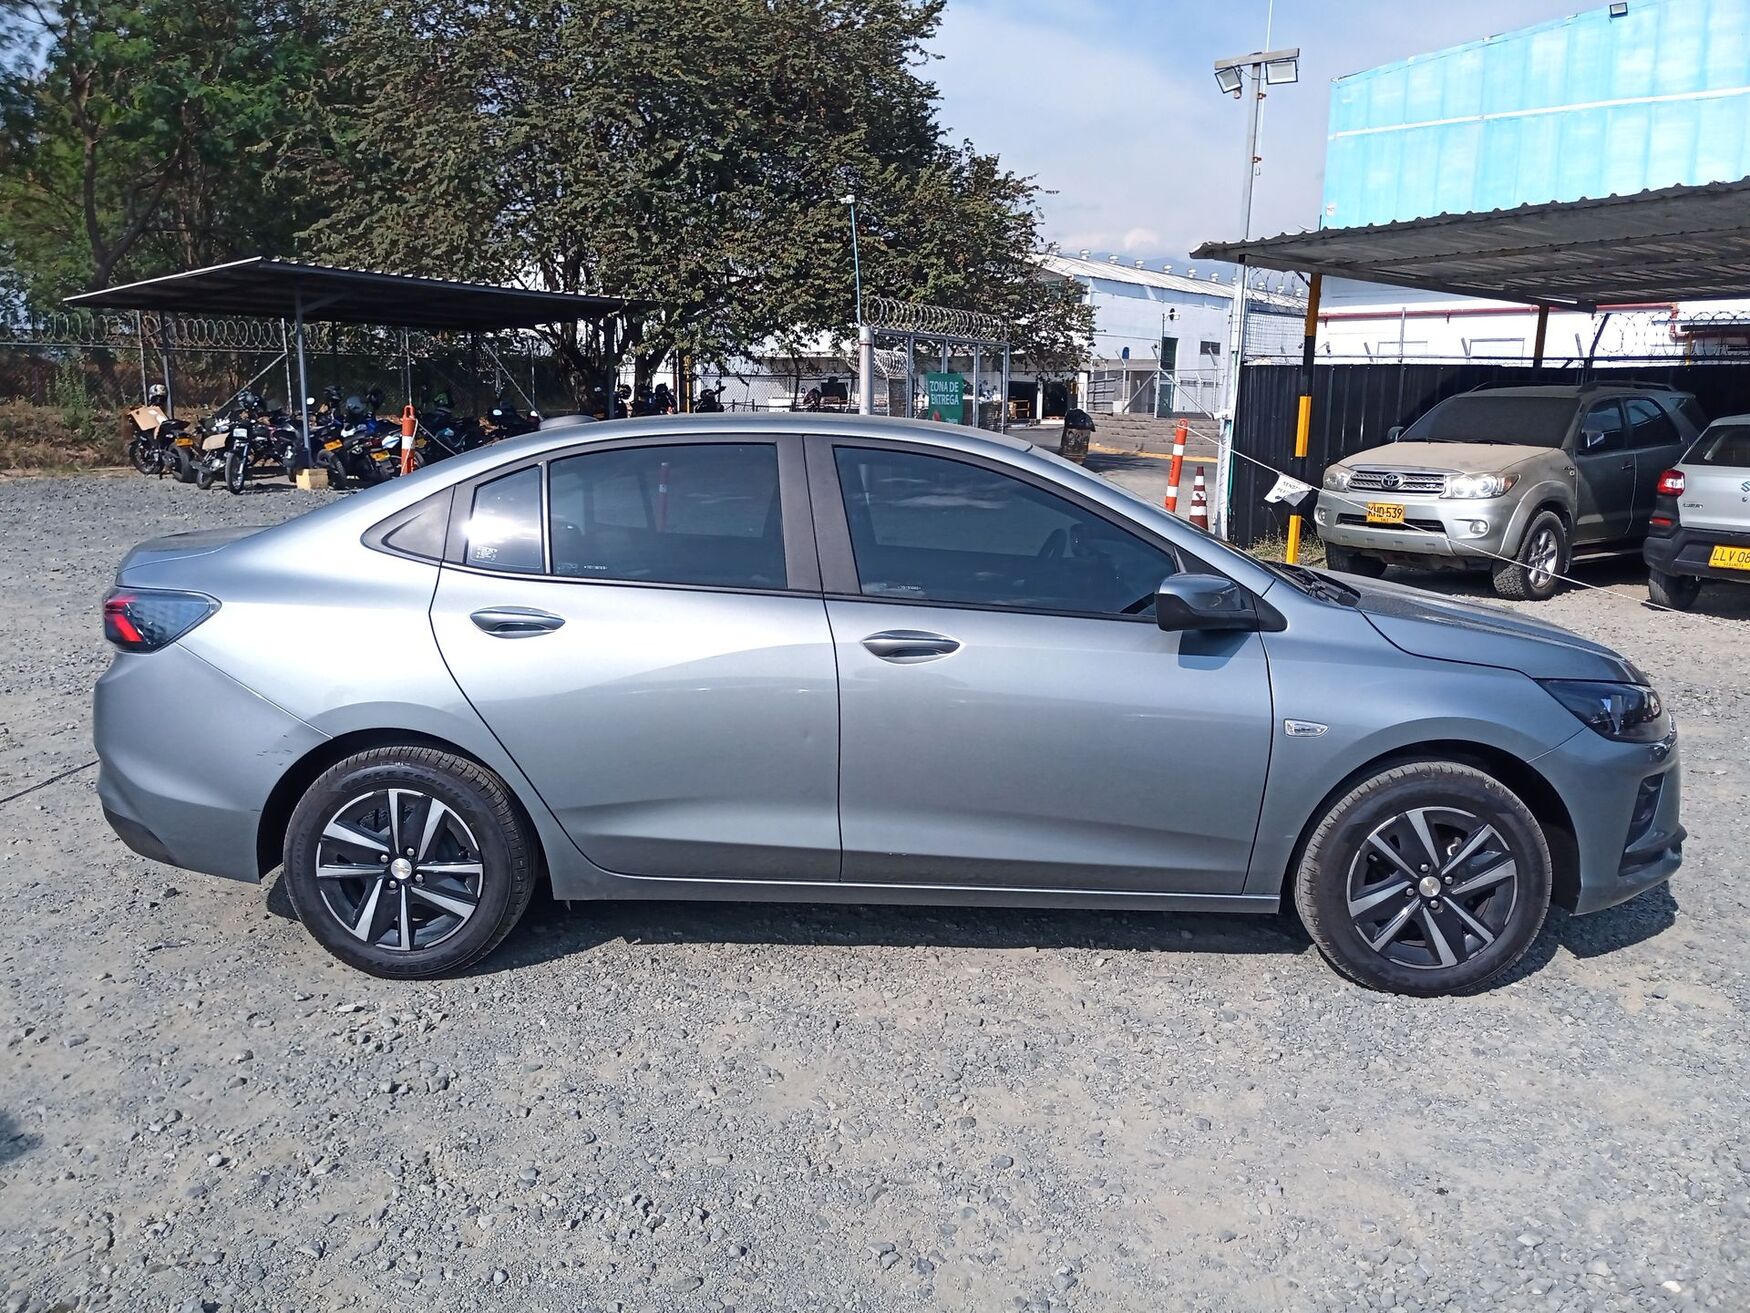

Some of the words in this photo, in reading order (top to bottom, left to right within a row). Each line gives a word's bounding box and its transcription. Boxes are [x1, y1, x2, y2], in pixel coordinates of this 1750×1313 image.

[930, 381, 949, 392] ZONA
[949, 382, 959, 392] DE
[931, 394, 959, 405] ENTREGA
[1386, 506, 1403, 519] 539
[1712, 548, 1737, 562] LLV
